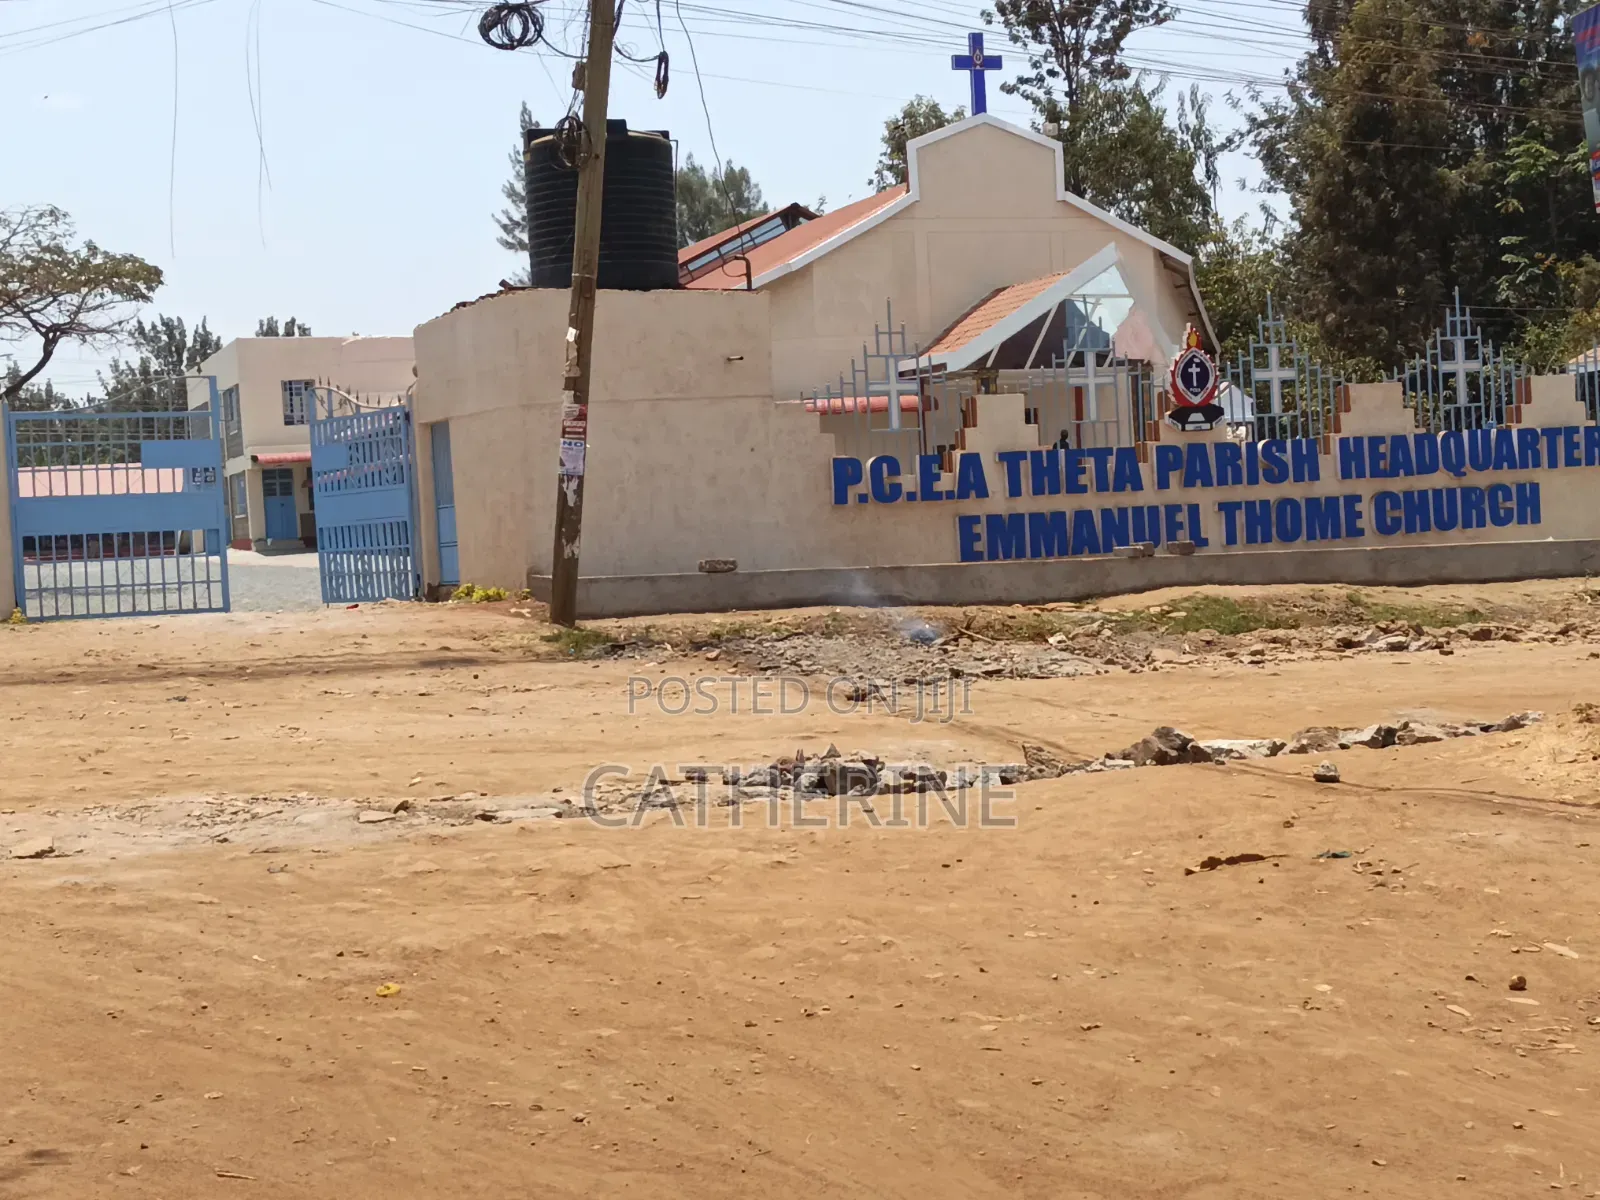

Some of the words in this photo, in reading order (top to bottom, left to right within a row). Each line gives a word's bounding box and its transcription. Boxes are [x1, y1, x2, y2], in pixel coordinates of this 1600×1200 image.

[834, 453, 986, 505] P.C.E.A
[1000, 447, 1144, 498] THETA
[1157, 439, 1318, 490] PARISH
[959, 503, 1208, 562] EMMANUEL
[1219, 494, 1365, 545] THOME
[1374, 482, 1541, 536] CHURCH
